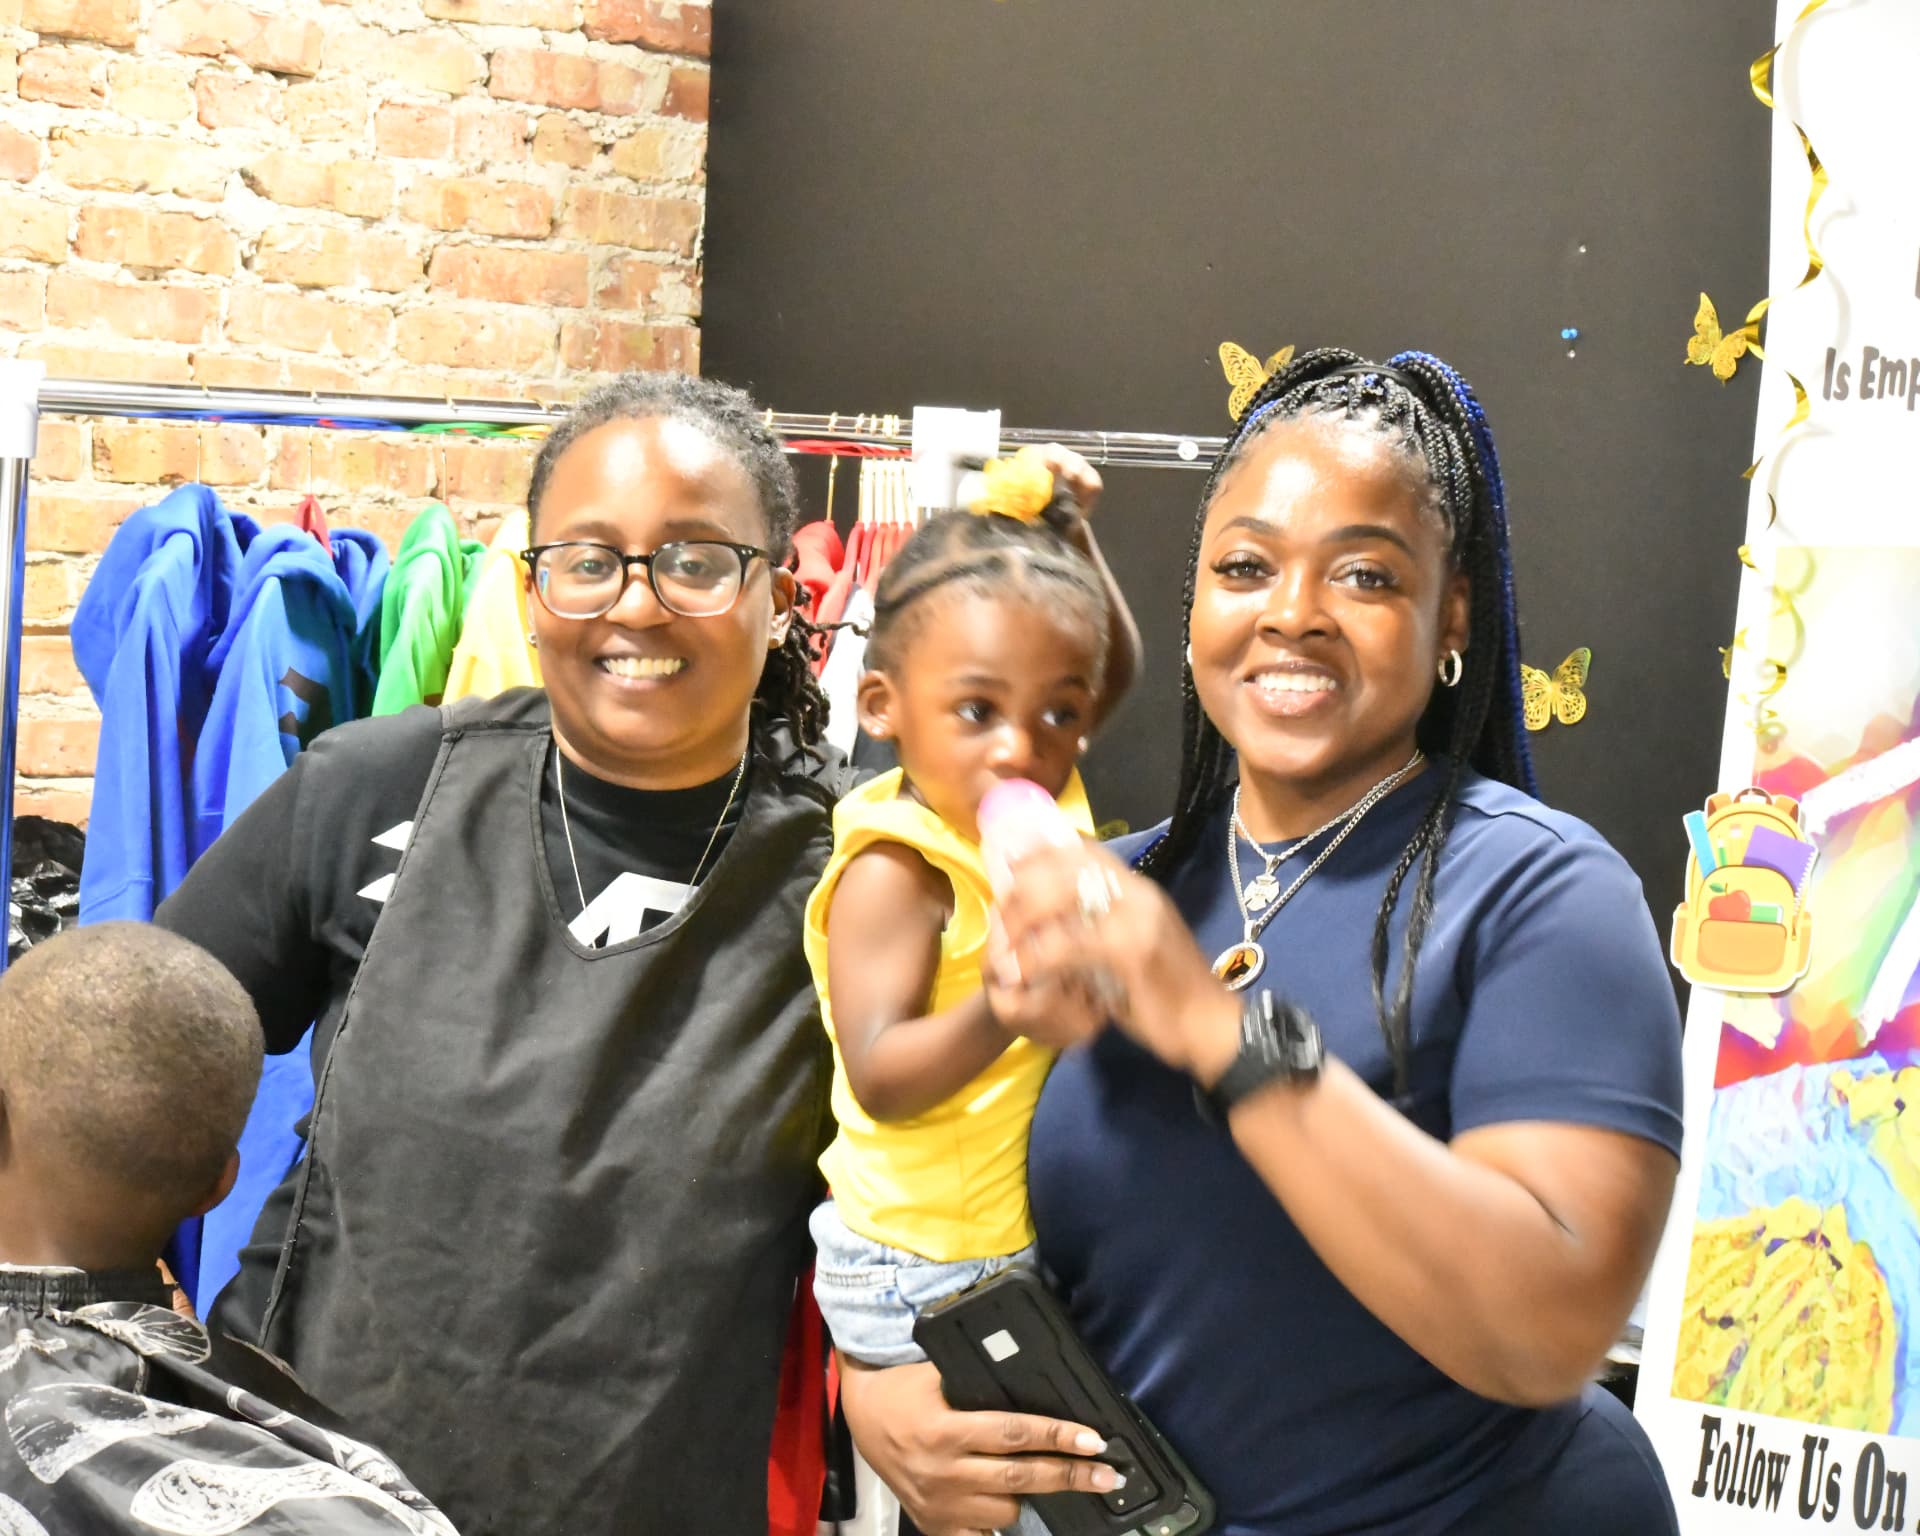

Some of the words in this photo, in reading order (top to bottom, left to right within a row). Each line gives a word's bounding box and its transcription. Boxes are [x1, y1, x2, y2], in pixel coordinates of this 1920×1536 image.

[1822, 346, 1851, 401] Is
[1691, 1414, 1791, 1513] Follow
[1798, 1434, 1842, 1523] Us
[1853, 1441, 1907, 1533] On
